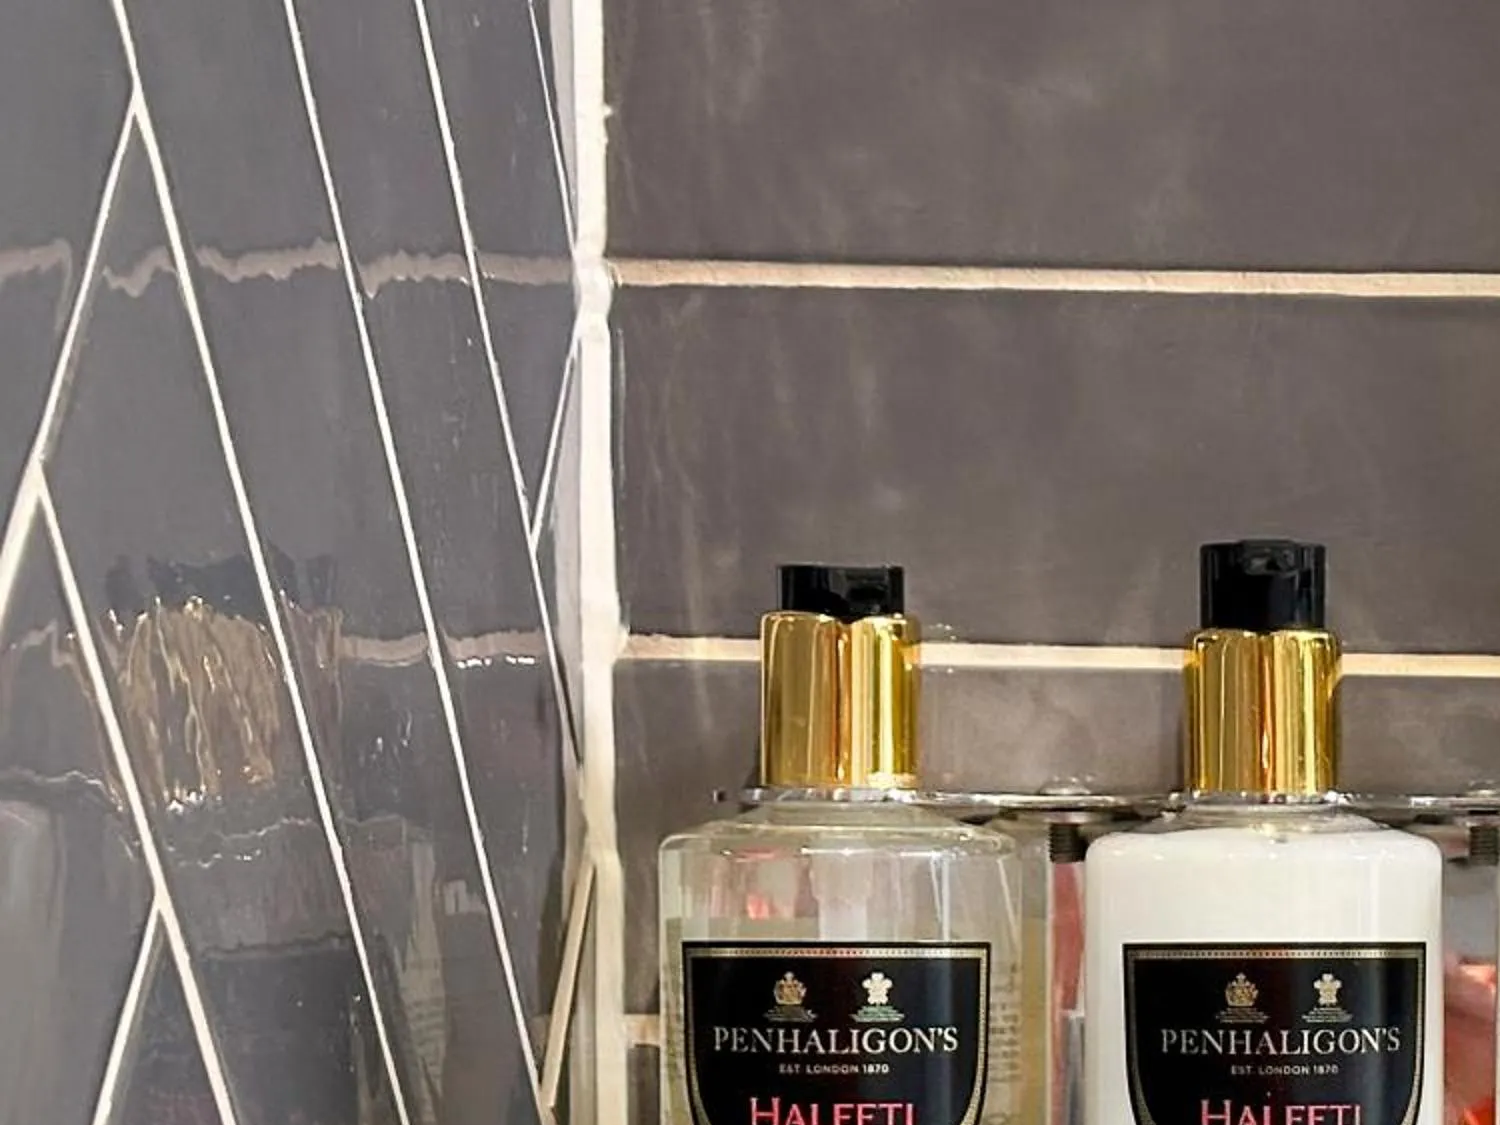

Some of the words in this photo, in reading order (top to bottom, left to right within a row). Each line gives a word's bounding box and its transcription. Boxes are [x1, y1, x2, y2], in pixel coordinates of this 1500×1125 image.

[713, 1026, 959, 1055] PENHALIGON'S
[1161, 1027, 1401, 1056] PENHALIGON'S
[806, 1063, 859, 1075] LONDON
[862, 1063, 890, 1075] 1870
[1258, 1064, 1310, 1076] LONDON
[1313, 1063, 1340, 1075] 1870
